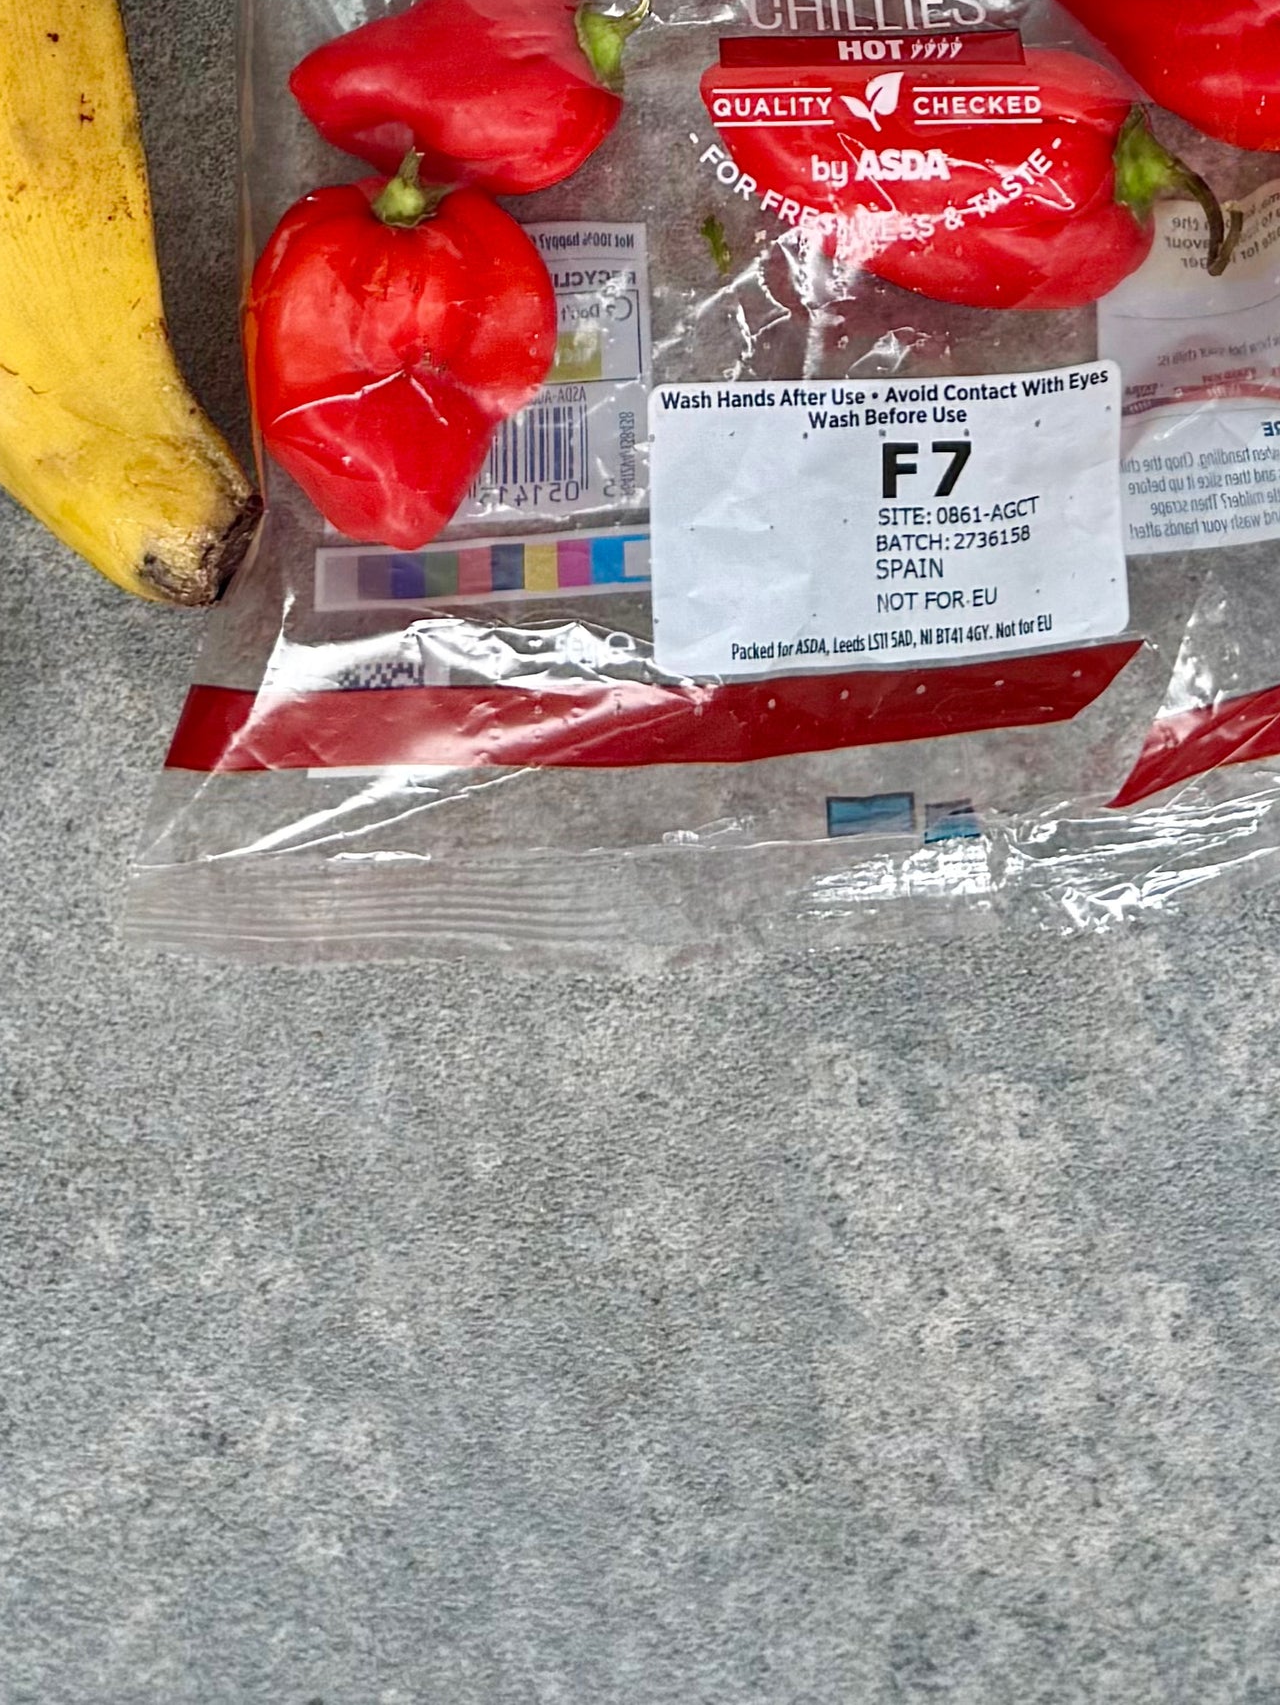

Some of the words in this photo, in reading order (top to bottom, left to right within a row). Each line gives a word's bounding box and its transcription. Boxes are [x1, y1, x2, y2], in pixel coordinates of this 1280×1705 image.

[839, 40, 902, 61] HOT
[713, 97, 833, 117] QUALITY
[913, 96, 1042, 115] CHECKED
[811, 155, 849, 187] by
[855, 149, 950, 181] ASDA
[700, 144, 757, 201] FOR
[943, 207, 964, 230] &
[968, 148, 1053, 219] TASTE
[661, 391, 712, 409] Wash
[717, 389, 775, 408] Hands
[780, 388, 827, 406] After
[831, 388, 865, 405] Use
[885, 385, 938, 403] Avoid
[944, 382, 1017, 400] Contact
[1022, 376, 1064, 397] With
[1069, 370, 1109, 391] Eyes
[808, 410, 860, 428] Wash
[865, 407, 927, 426] Before
[933, 406, 967, 423] Use
[878, 507, 931, 525] SITE:
[937, 496, 1040, 525] 0861-AGCT
[876, 534, 950, 552] BATCH:
[954, 525, 1030, 550] 2736158
[876, 558, 943, 580] SPAIN
[877, 592, 919, 613] NOT
[925, 590, 965, 609] FOR
[973, 587, 998, 607] EU
[732, 642, 774, 660] Packed
[778, 641, 793, 658] for
[795, 639, 829, 657] ASDA,
[834, 635, 865, 653] Leeds
[891, 630, 917, 649] 5AD,
[920, 628, 932, 645] NI
[936, 627, 964, 644] BT41
[966, 624, 993, 642] 4GY.
[996, 622, 1015, 639] Not
[1019, 617, 1034, 636] for
[1038, 614, 1052, 631] EU
